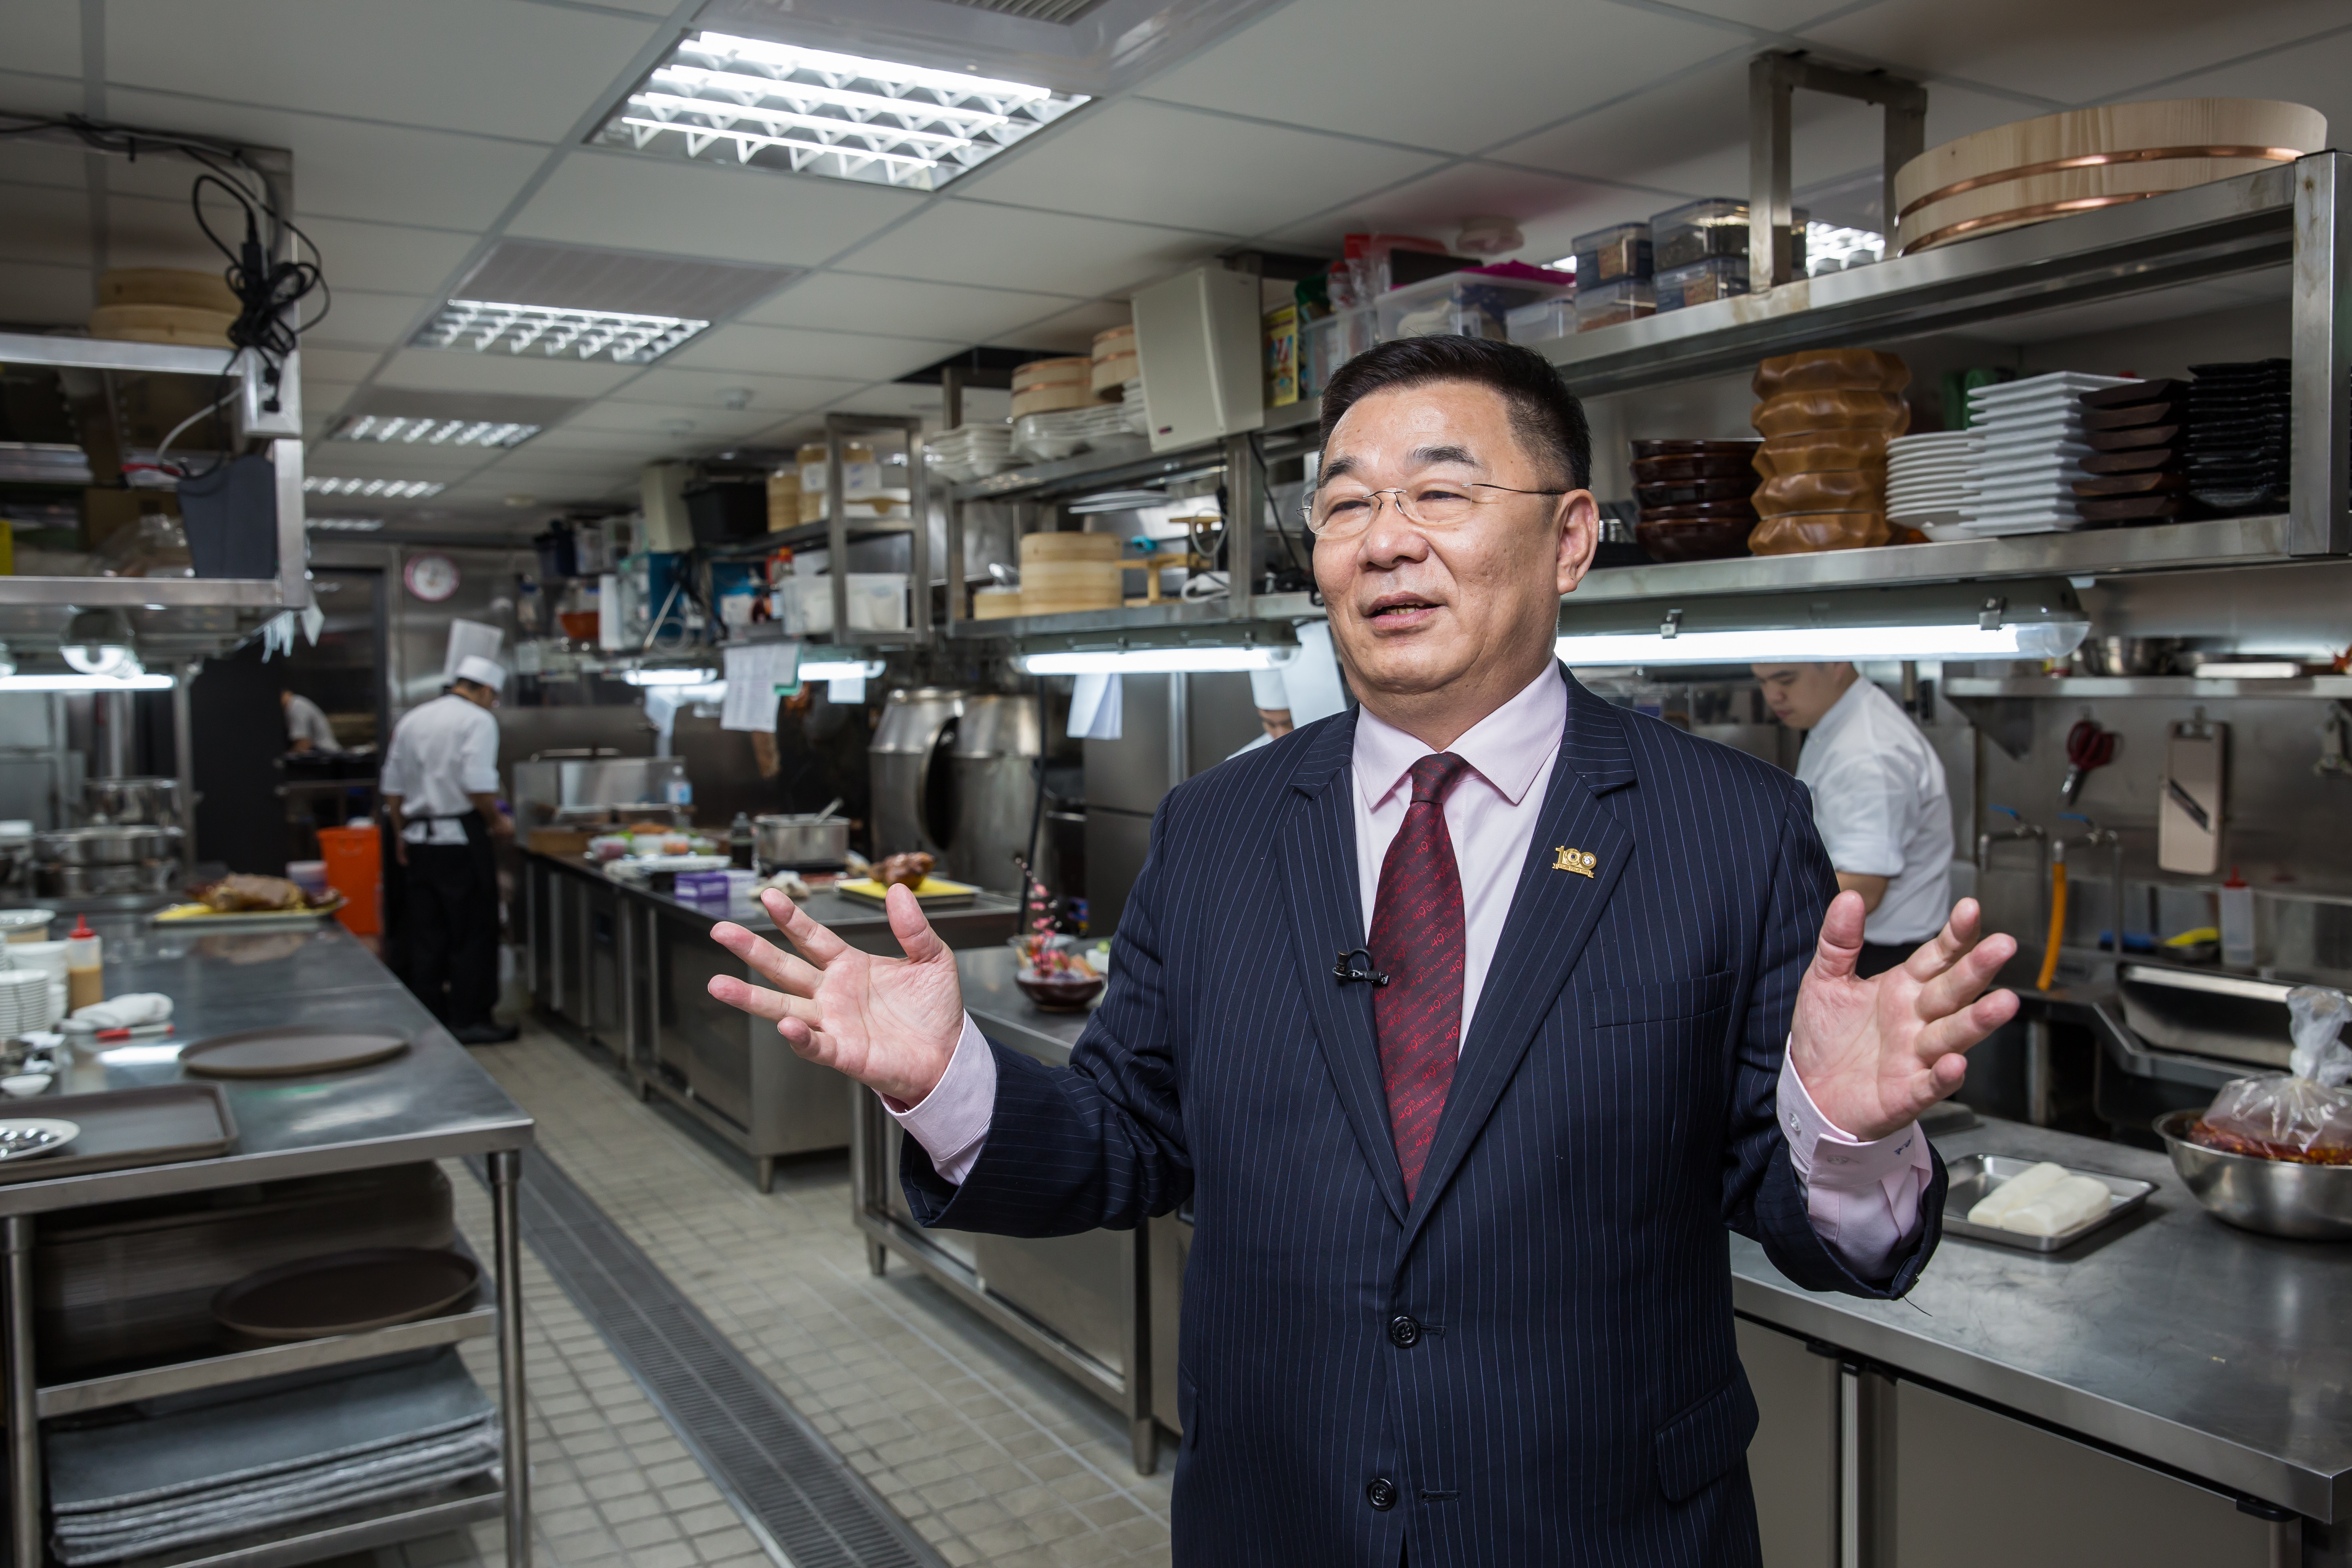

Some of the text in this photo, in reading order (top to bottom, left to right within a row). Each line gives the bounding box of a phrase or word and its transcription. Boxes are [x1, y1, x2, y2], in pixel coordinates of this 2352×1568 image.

[1405, 855, 1419, 866] The
[1415, 834, 1431, 855] 49th
[1406, 826, 1426, 845] FORUM
[1427, 817, 1437, 826] The
[1555, 845, 1597, 870] 100
[1378, 915, 1391, 935] 49th
[1403, 891, 1424, 911] FORUM
[1425, 881, 1437, 891] The
[1434, 861, 1447, 881] 49th
[1388, 895, 1399, 906] The
[1395, 874, 1410, 895] 49th
[1408, 869, 1426, 886] OSEAL
[1425, 853, 1443, 871] FORUM
[1404, 921, 1416, 932] The
[1412, 900, 1429, 920] 49th
[1426, 895, 1444, 911] OSEAL
[1442, 879, 1459, 898] FORUM
[1393, 940, 1408, 961] 49th
[1405, 935, 1424, 952] OSEAL
[1422, 918, 1443, 937] FORUM
[1443, 909, 1454, 918] The
[1451, 888, 1462, 908] 49th
[1380, 944, 1461, 1018] FORUM The 49th OSEAL FORUM
[1386, 976, 1403, 993] OSEAL
[1401, 958, 1421, 977] FORUM
[1422, 947, 1434, 958] The
[1431, 927, 1447, 947] 49th
[1444, 922, 1462, 939] OSEAL
[1379, 953, 1465, 1039] The 49th OSEAL FORUM The 49th
[1380, 988, 1460, 1059] OSEAL FORUM The 49th OSEAL
[1396, 1054, 1407, 1065] The
[1404, 1033, 1421, 1053] 49th
[1418, 1028, 1438, 1045] OSEAL
[1436, 1011, 1457, 1030] FORUM
[1395, 1068, 1415, 1085] OSEAL
[1413, 1050, 1434, 1070] FORUM
[1435, 1040, 1448, 1051] The
[1445, 1020, 1461, 1040] 49th
[1390, 1054, 1457, 1109] FORUM The 49th OSEAL
[1398, 1099, 1416, 1119] 49th
[1412, 1095, 1432, 1111] OSEAL
[1431, 1078, 1452, 1097] FORUM
[1405, 1148, 1419, 1159] The
[1415, 1126, 1433, 1147] 49th
[1407, 1117, 1428, 1136] FORUM
[1430, 1107, 1442, 1118] The
